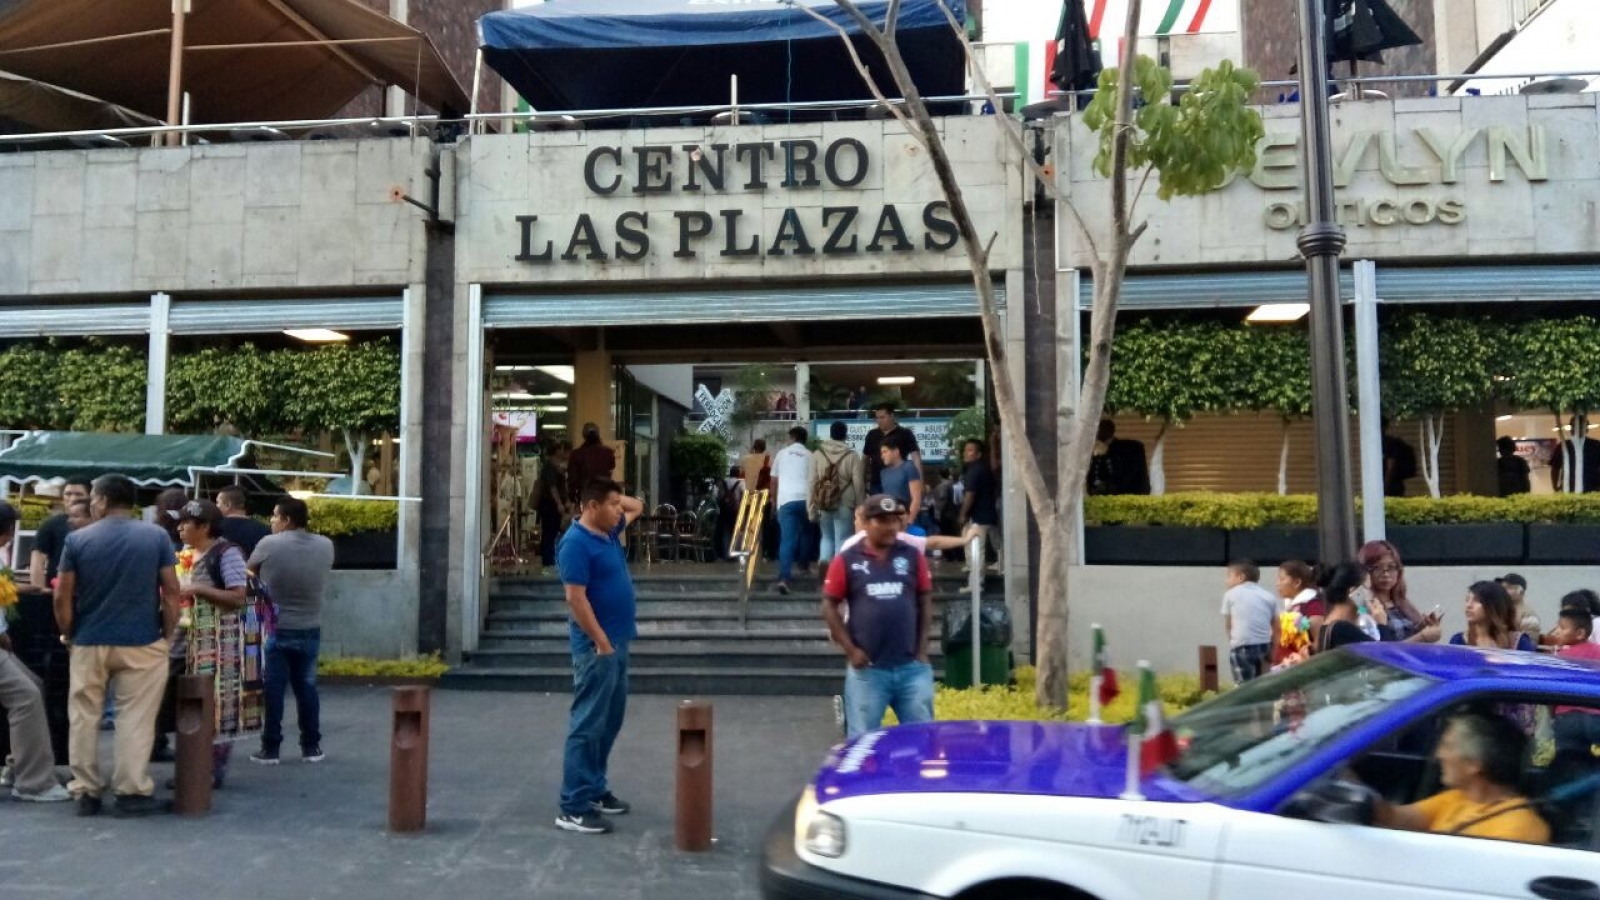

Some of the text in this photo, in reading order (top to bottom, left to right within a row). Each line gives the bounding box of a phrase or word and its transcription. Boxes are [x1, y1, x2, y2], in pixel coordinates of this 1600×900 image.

[583, 137, 870, 196] CENTRO
[1213, 124, 1548, 190] EVLYN
[514, 200, 960, 262] LAS PLAZAS
[1263, 200, 1466, 230] OTICOS
